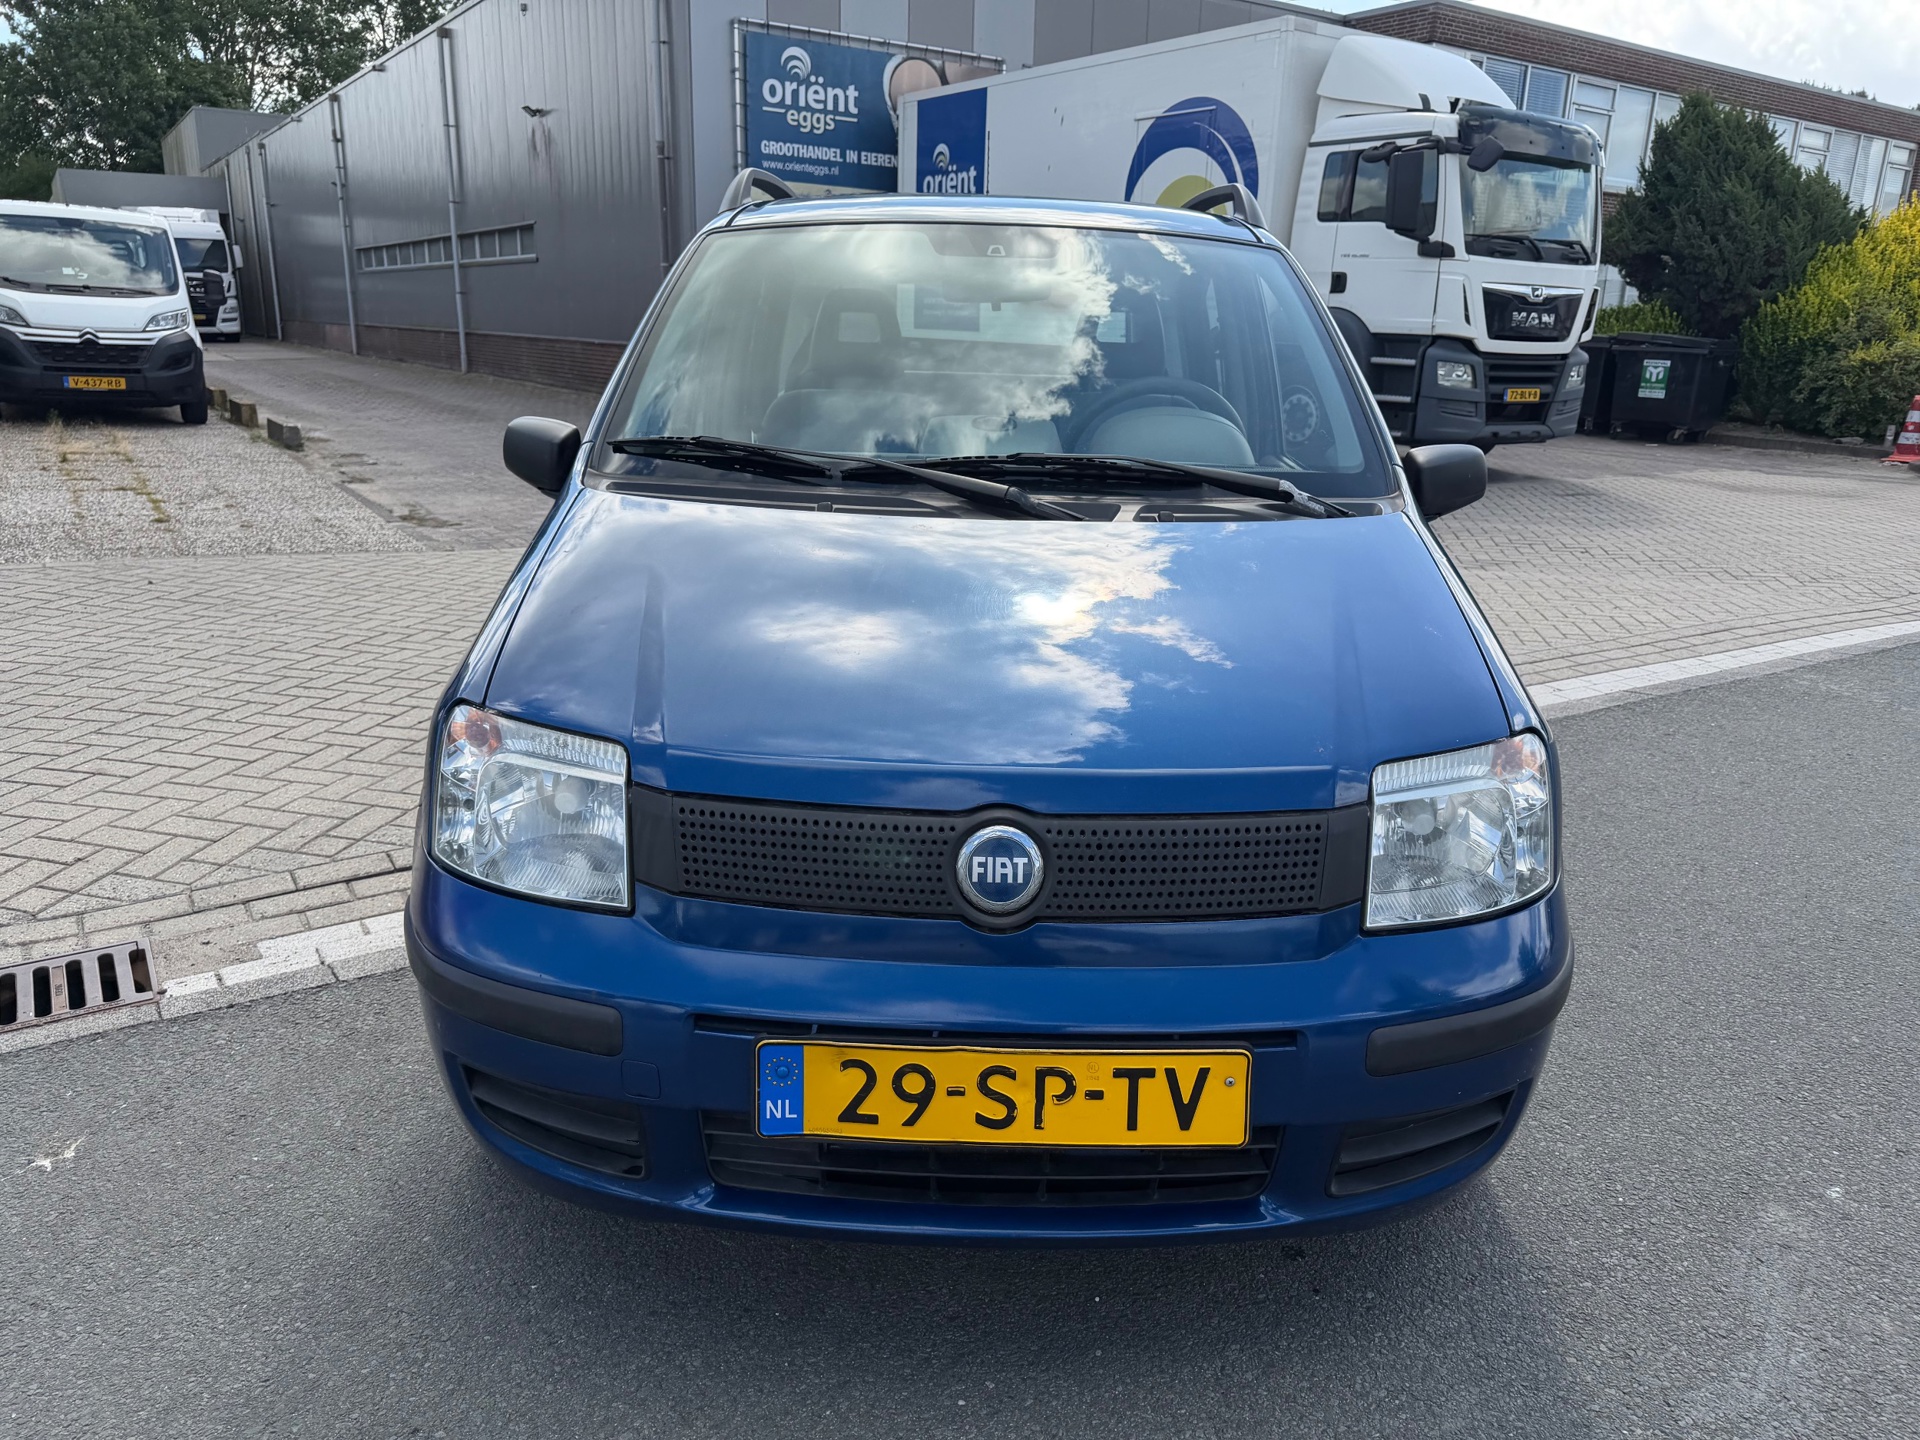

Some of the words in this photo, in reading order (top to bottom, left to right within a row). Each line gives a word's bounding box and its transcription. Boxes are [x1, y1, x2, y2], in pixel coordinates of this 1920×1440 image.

[762, 75, 859, 114] oriënt
[786, 109, 835, 134] eggs
[761, 140, 843, 162] GROOTHANDEL
[846, 149, 858, 164] IN
[861, 151, 898, 168] EIEREN
[761, 160, 839, 176] www.orienteggs.nl
[923, 164, 977, 194] oriënt
[1511, 311, 1555, 328] MAN
[72, 378, 122, 388] V-437-RB
[972, 856, 1028, 884] FIAT
[837, 1058, 1211, 1132] 29-SP-TV
[766, 1099, 798, 1119] NL
